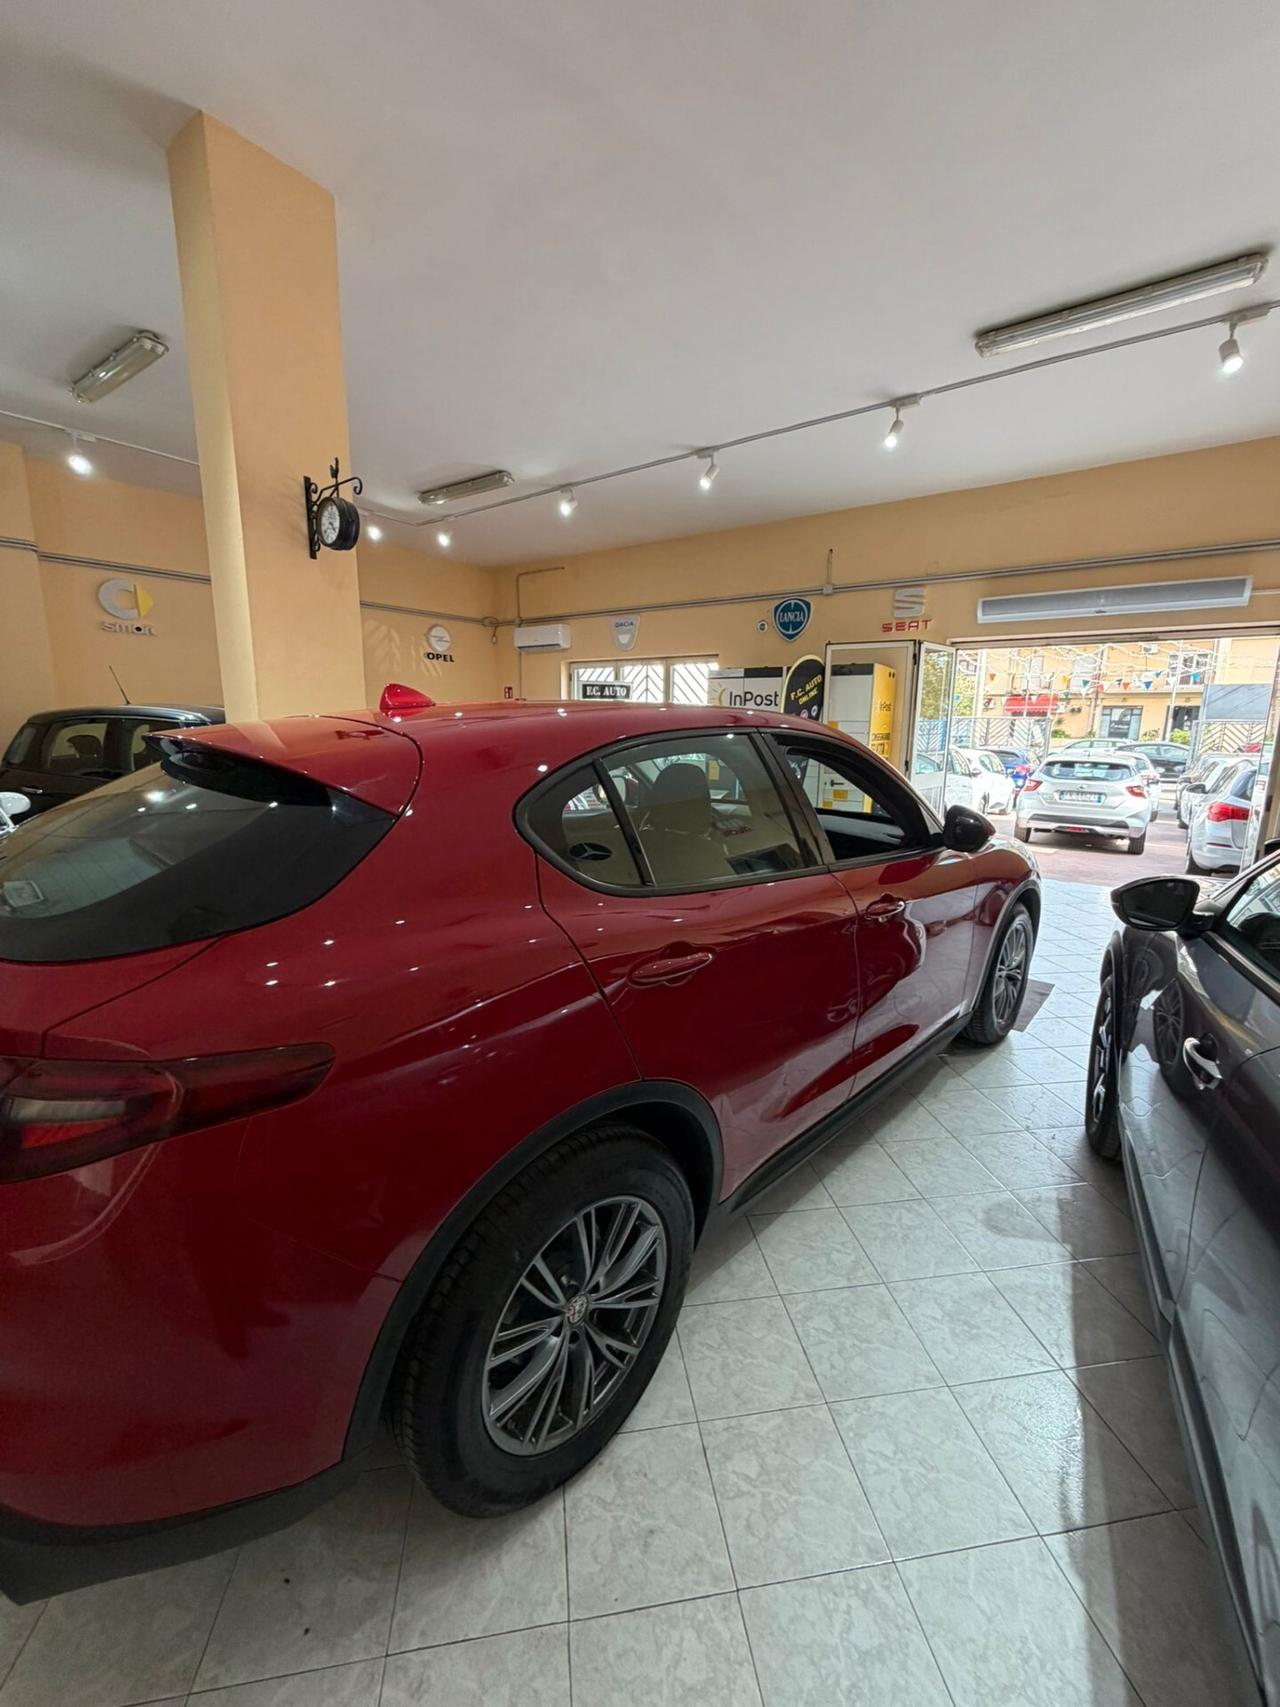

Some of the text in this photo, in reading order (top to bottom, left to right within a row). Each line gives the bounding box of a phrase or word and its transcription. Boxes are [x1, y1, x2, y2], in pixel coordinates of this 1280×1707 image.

[779, 611, 804, 623] LANCIA
[881, 619, 932, 633] SEAT
[427, 652, 455, 663] OPEL
[804, 674, 823, 691] AUTO
[603, 686, 627, 697] AUTO
[729, 690, 779, 707] InPost
[798, 687, 818, 705] ONLINE
